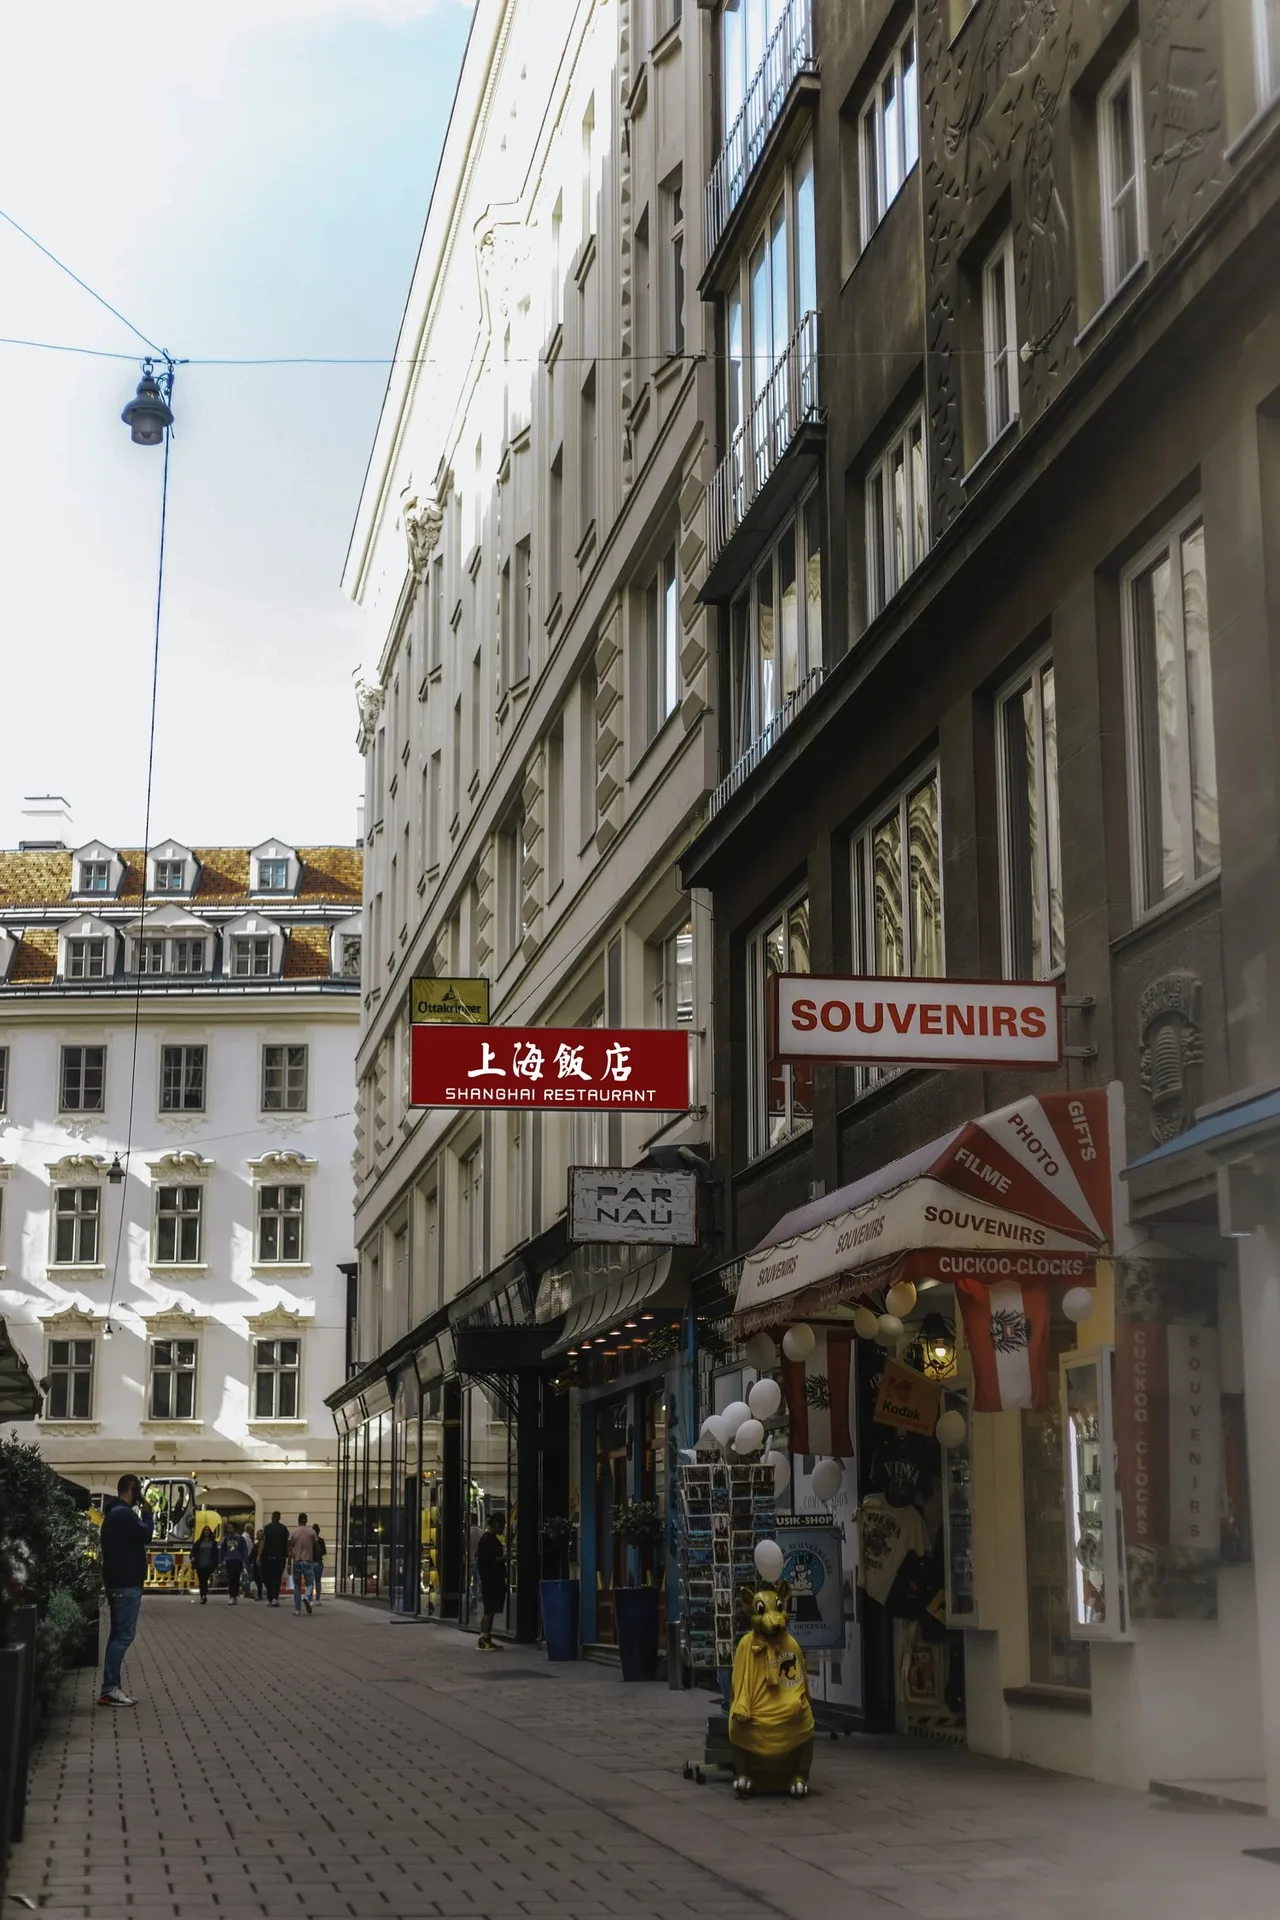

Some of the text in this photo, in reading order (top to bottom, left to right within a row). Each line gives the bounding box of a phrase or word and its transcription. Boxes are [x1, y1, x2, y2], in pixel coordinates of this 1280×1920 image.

[790, 999, 1047, 1038] SOUVENIRS
[467, 1041, 632, 1082] 上海飯店
[445, 1087, 656, 1102] SHANGHAI RESTAURANT
[1007, 1113, 1060, 1177] PHOTO
[1068, 1101, 1097, 1162] GIFTS
[954, 1146, 1012, 1194] FILME
[597, 1187, 672, 1203] PAR
[596, 1208, 672, 1224] NAU
[835, 1215, 885, 1254] SOUVENIRS
[924, 1206, 1046, 1245] SOUVENIRS
[757, 1254, 799, 1287] SOUVENIRS
[938, 1256, 1084, 1276] CUCKOO-CLOCKS
[883, 1400, 922, 1421] Kodak
[1188, 1335, 1202, 1538] SOUVENIRS
[776, 1515, 833, 1526] USIK-SHOP
